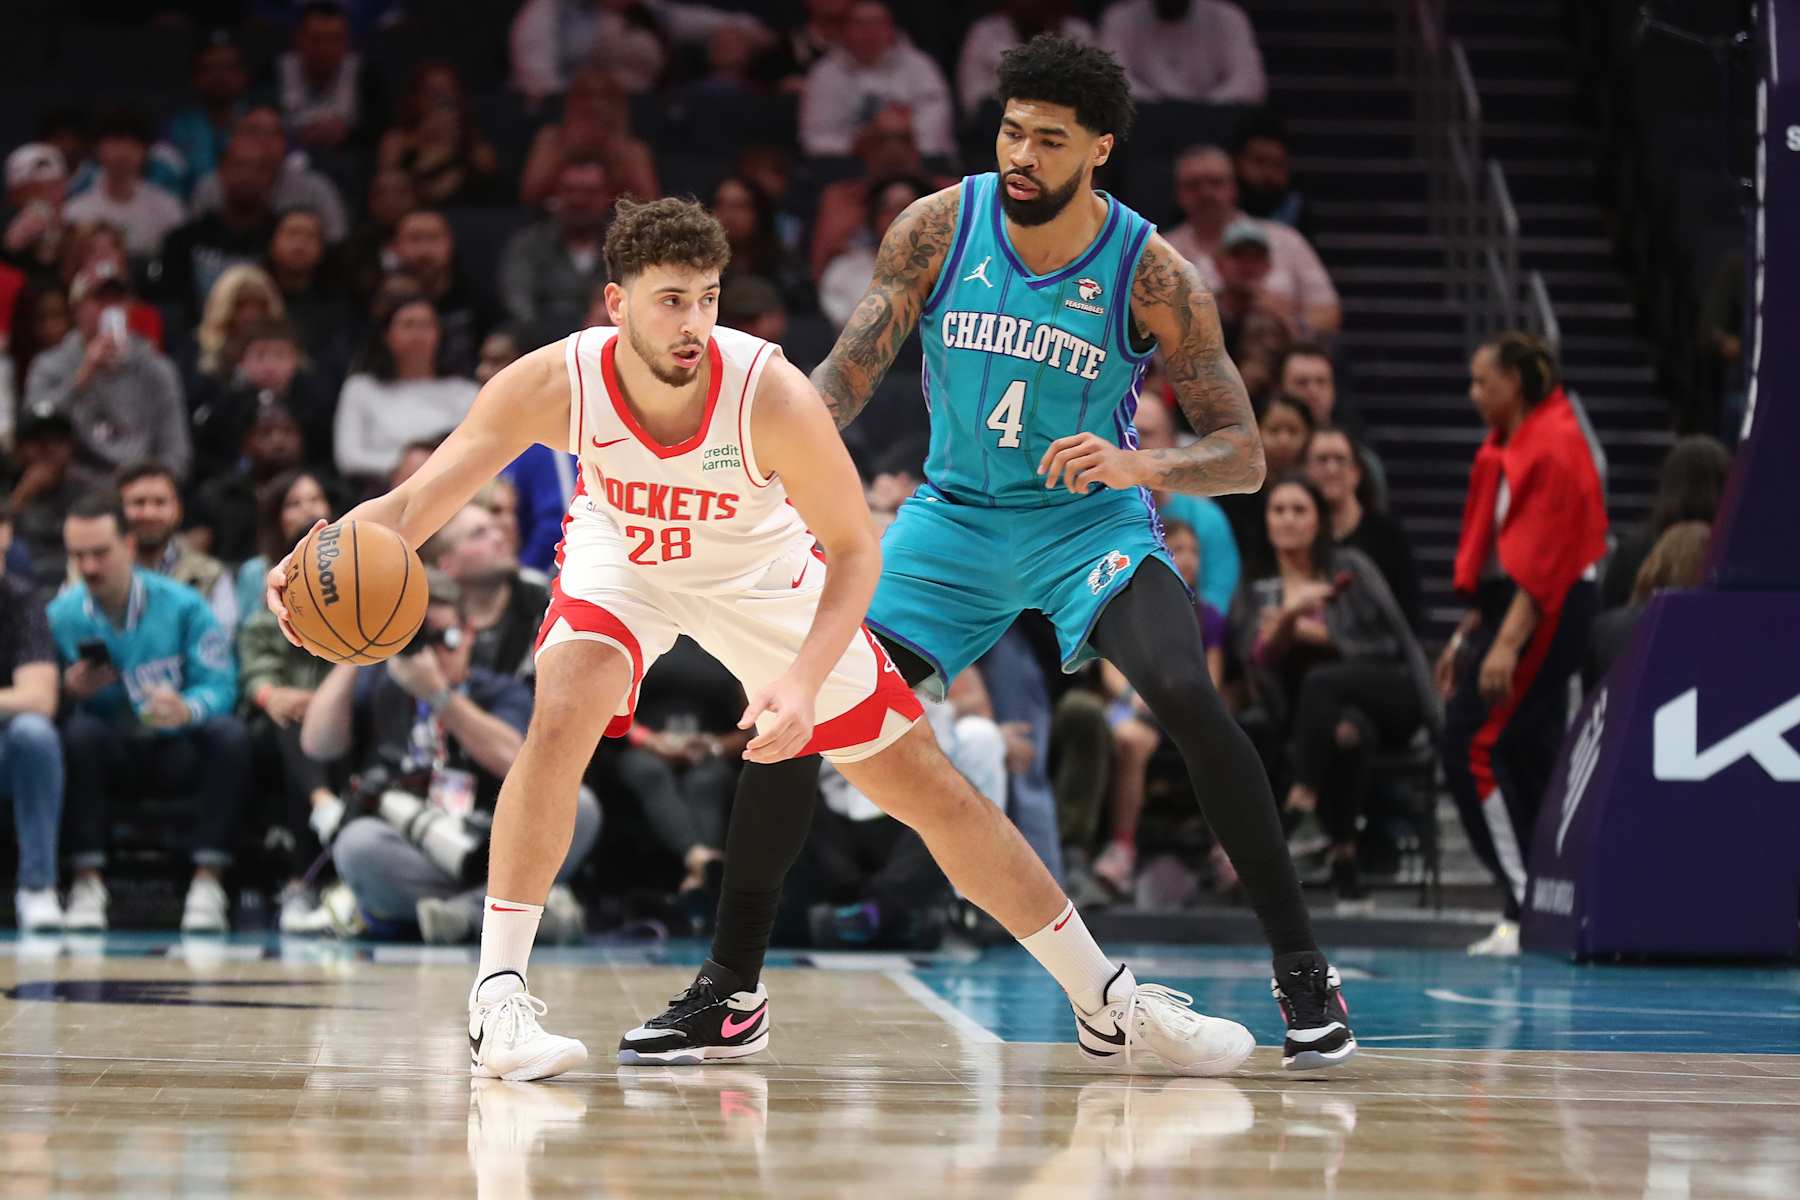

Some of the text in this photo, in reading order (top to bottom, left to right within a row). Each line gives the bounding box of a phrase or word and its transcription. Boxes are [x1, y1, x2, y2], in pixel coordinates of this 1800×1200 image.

[942, 311, 1107, 380] CHARLOTTE
[986, 380, 1027, 448] 4
[702, 457, 741, 472] karma
[703, 444, 739, 459] credit
[592, 464, 740, 521] OCKETS
[625, 525, 692, 566] 28
